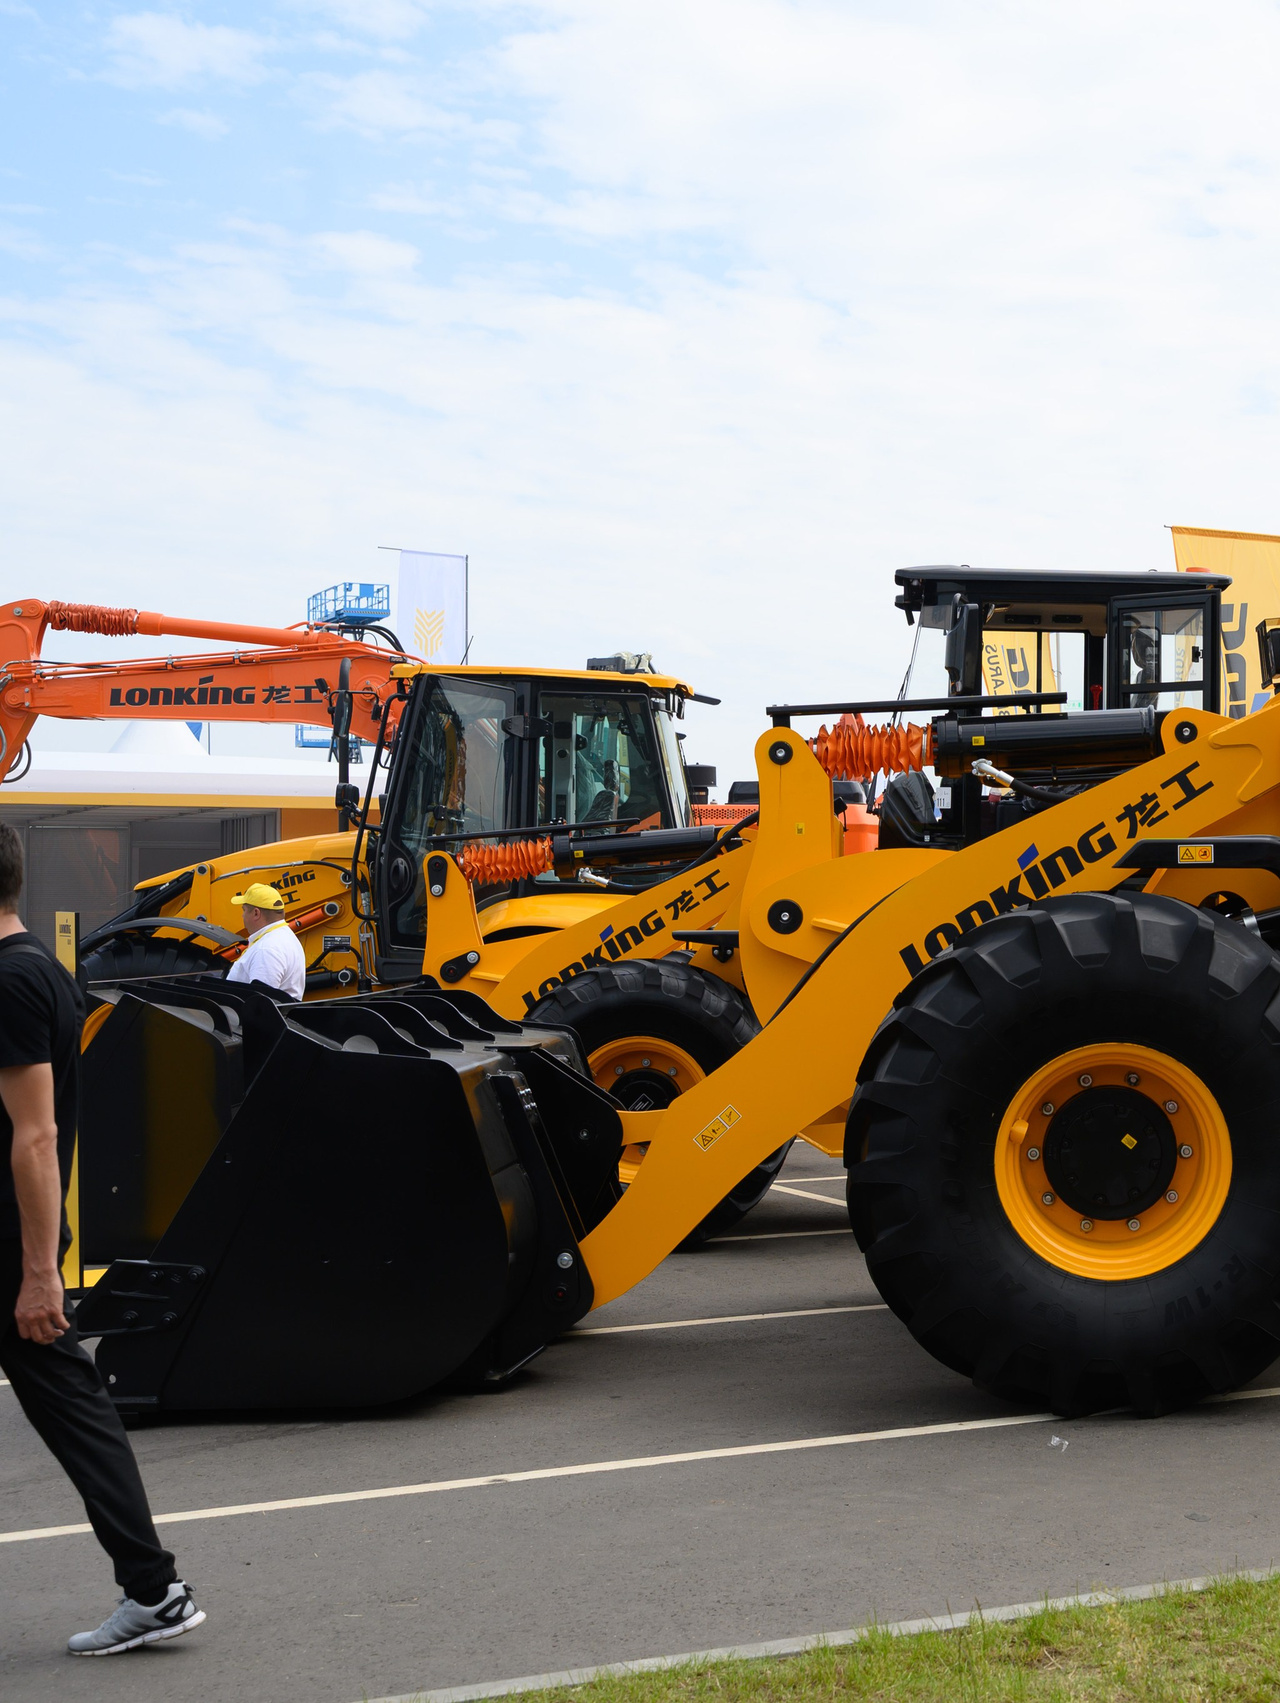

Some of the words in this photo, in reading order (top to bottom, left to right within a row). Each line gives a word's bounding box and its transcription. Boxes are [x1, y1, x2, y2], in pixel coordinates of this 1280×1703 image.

[109, 674, 256, 707] LONKING
[261, 685, 324, 704] 龙工
[1115, 760, 1215, 839] 龙工
[235, 869, 316, 897] KING
[664, 868, 730, 920] 龙工
